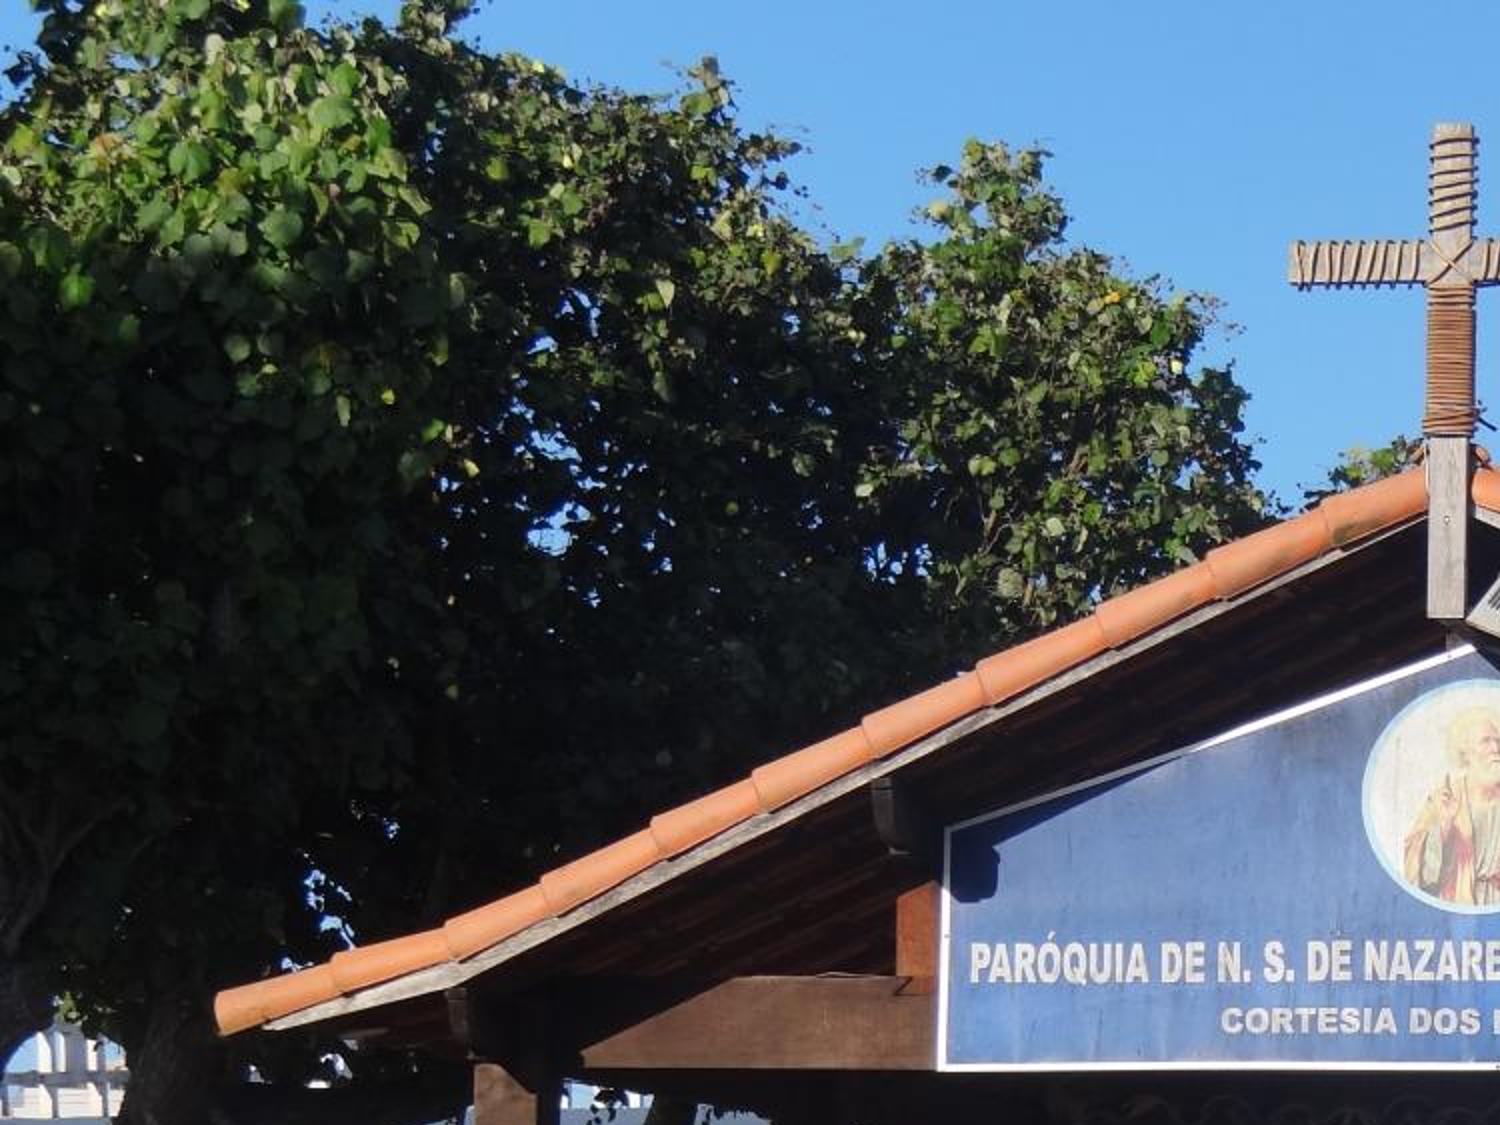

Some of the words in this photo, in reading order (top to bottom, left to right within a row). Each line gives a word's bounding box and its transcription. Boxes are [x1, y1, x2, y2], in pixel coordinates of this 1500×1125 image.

[969, 931, 1150, 986] PARÓQUIA
[1160, 941, 1206, 984] DE
[1217, 941, 1252, 984] N.
[1262, 940, 1296, 984] S.
[1306, 940, 1354, 983] DE
[1221, 1007, 1398, 1035] CORTESIA
[1409, 1007, 1481, 1035] DOS
